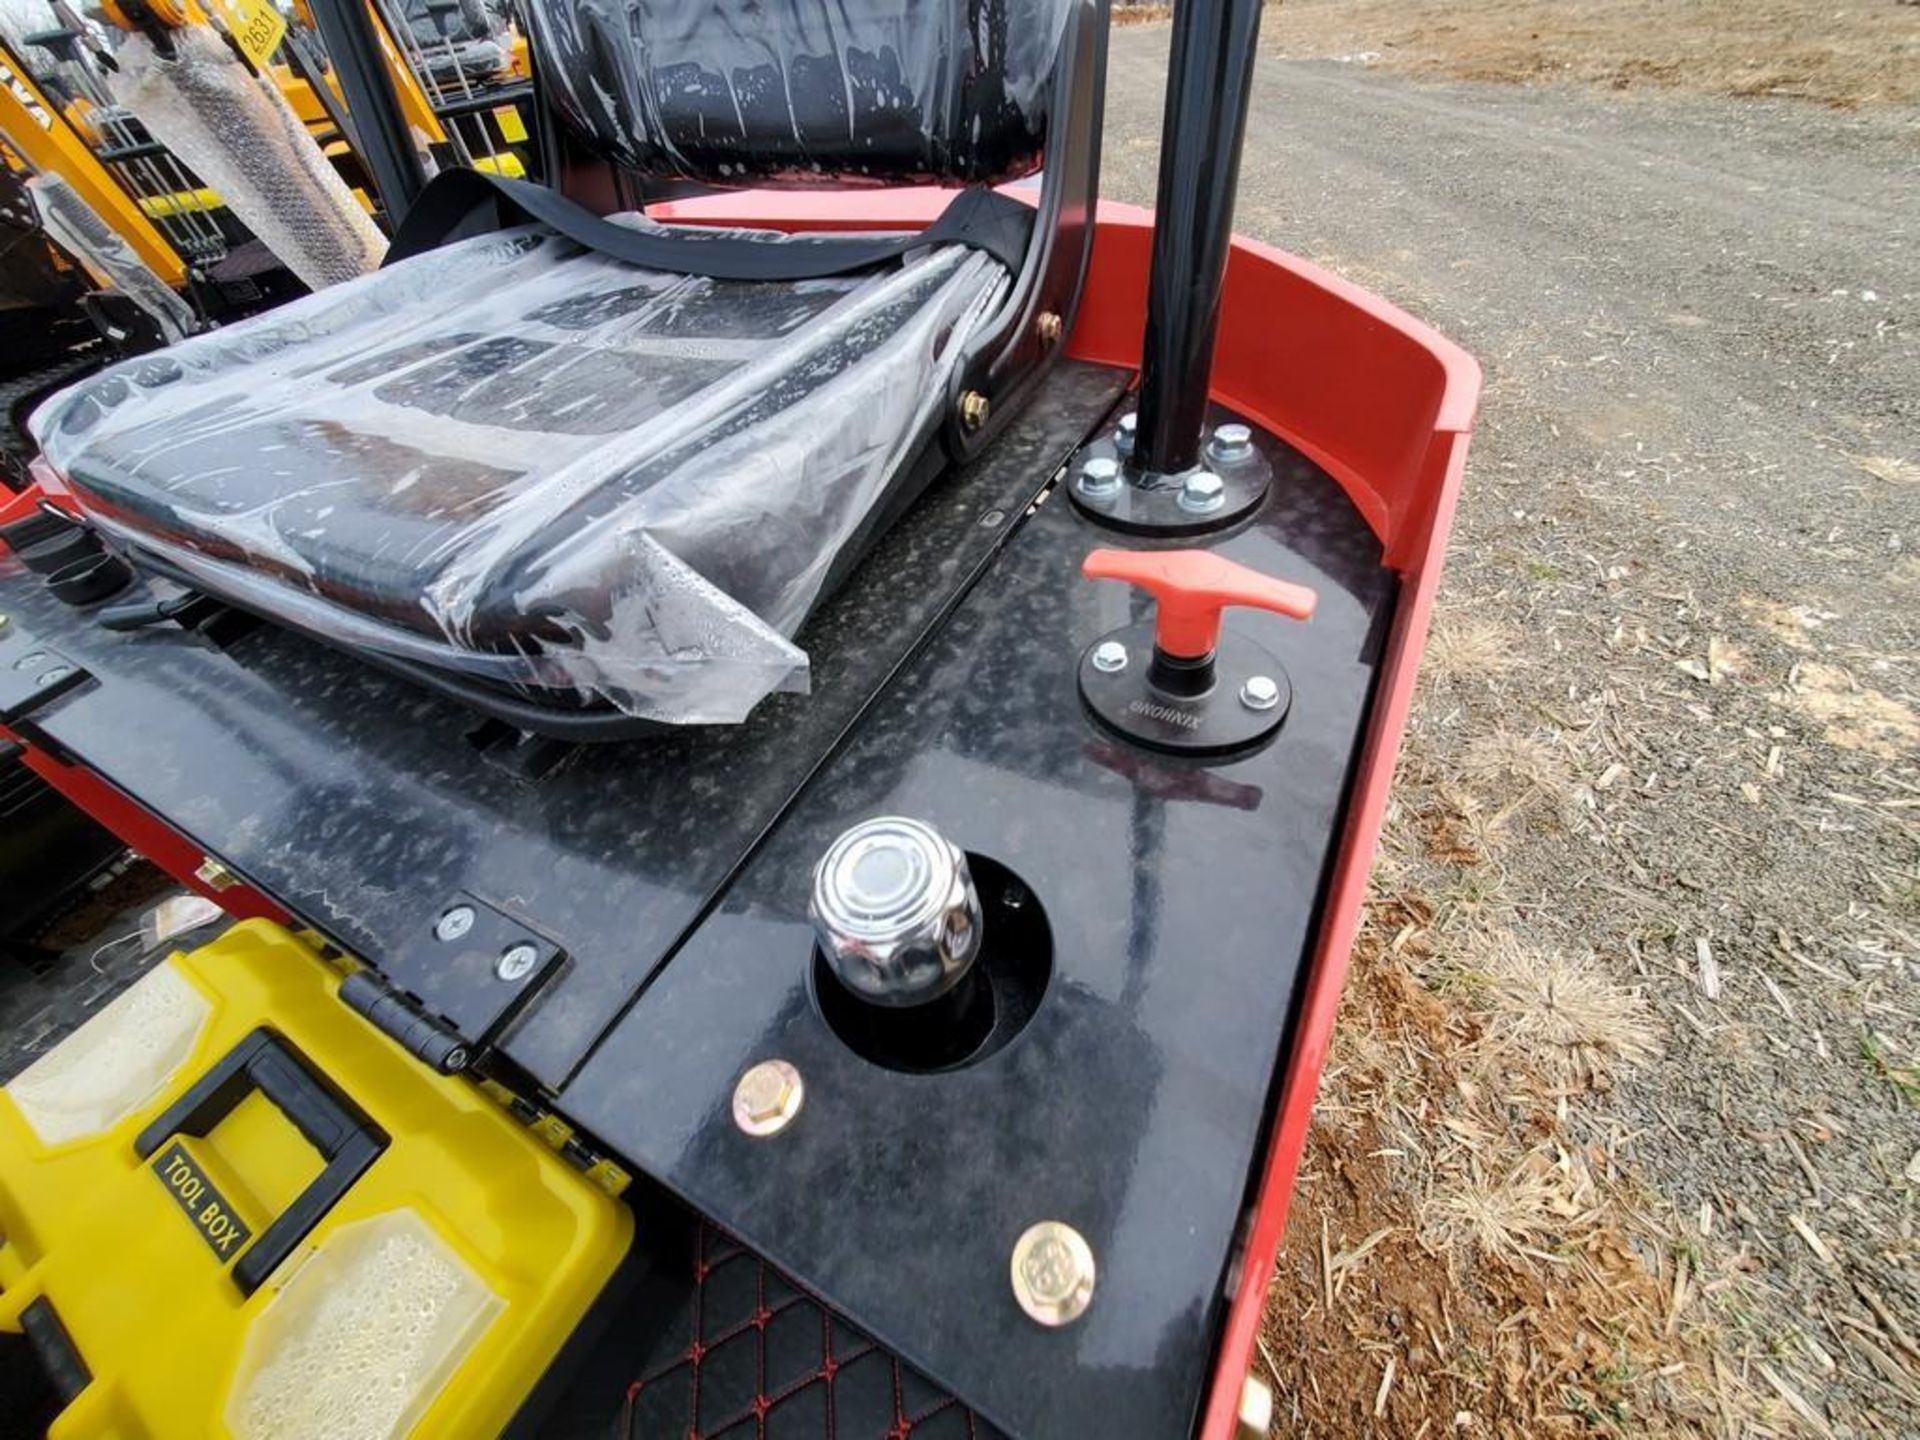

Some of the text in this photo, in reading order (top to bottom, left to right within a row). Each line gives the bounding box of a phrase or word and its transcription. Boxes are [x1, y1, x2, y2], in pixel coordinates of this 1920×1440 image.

[243, 9, 275, 53] 2631
[164, 1154, 240, 1251] TOOL BOX
